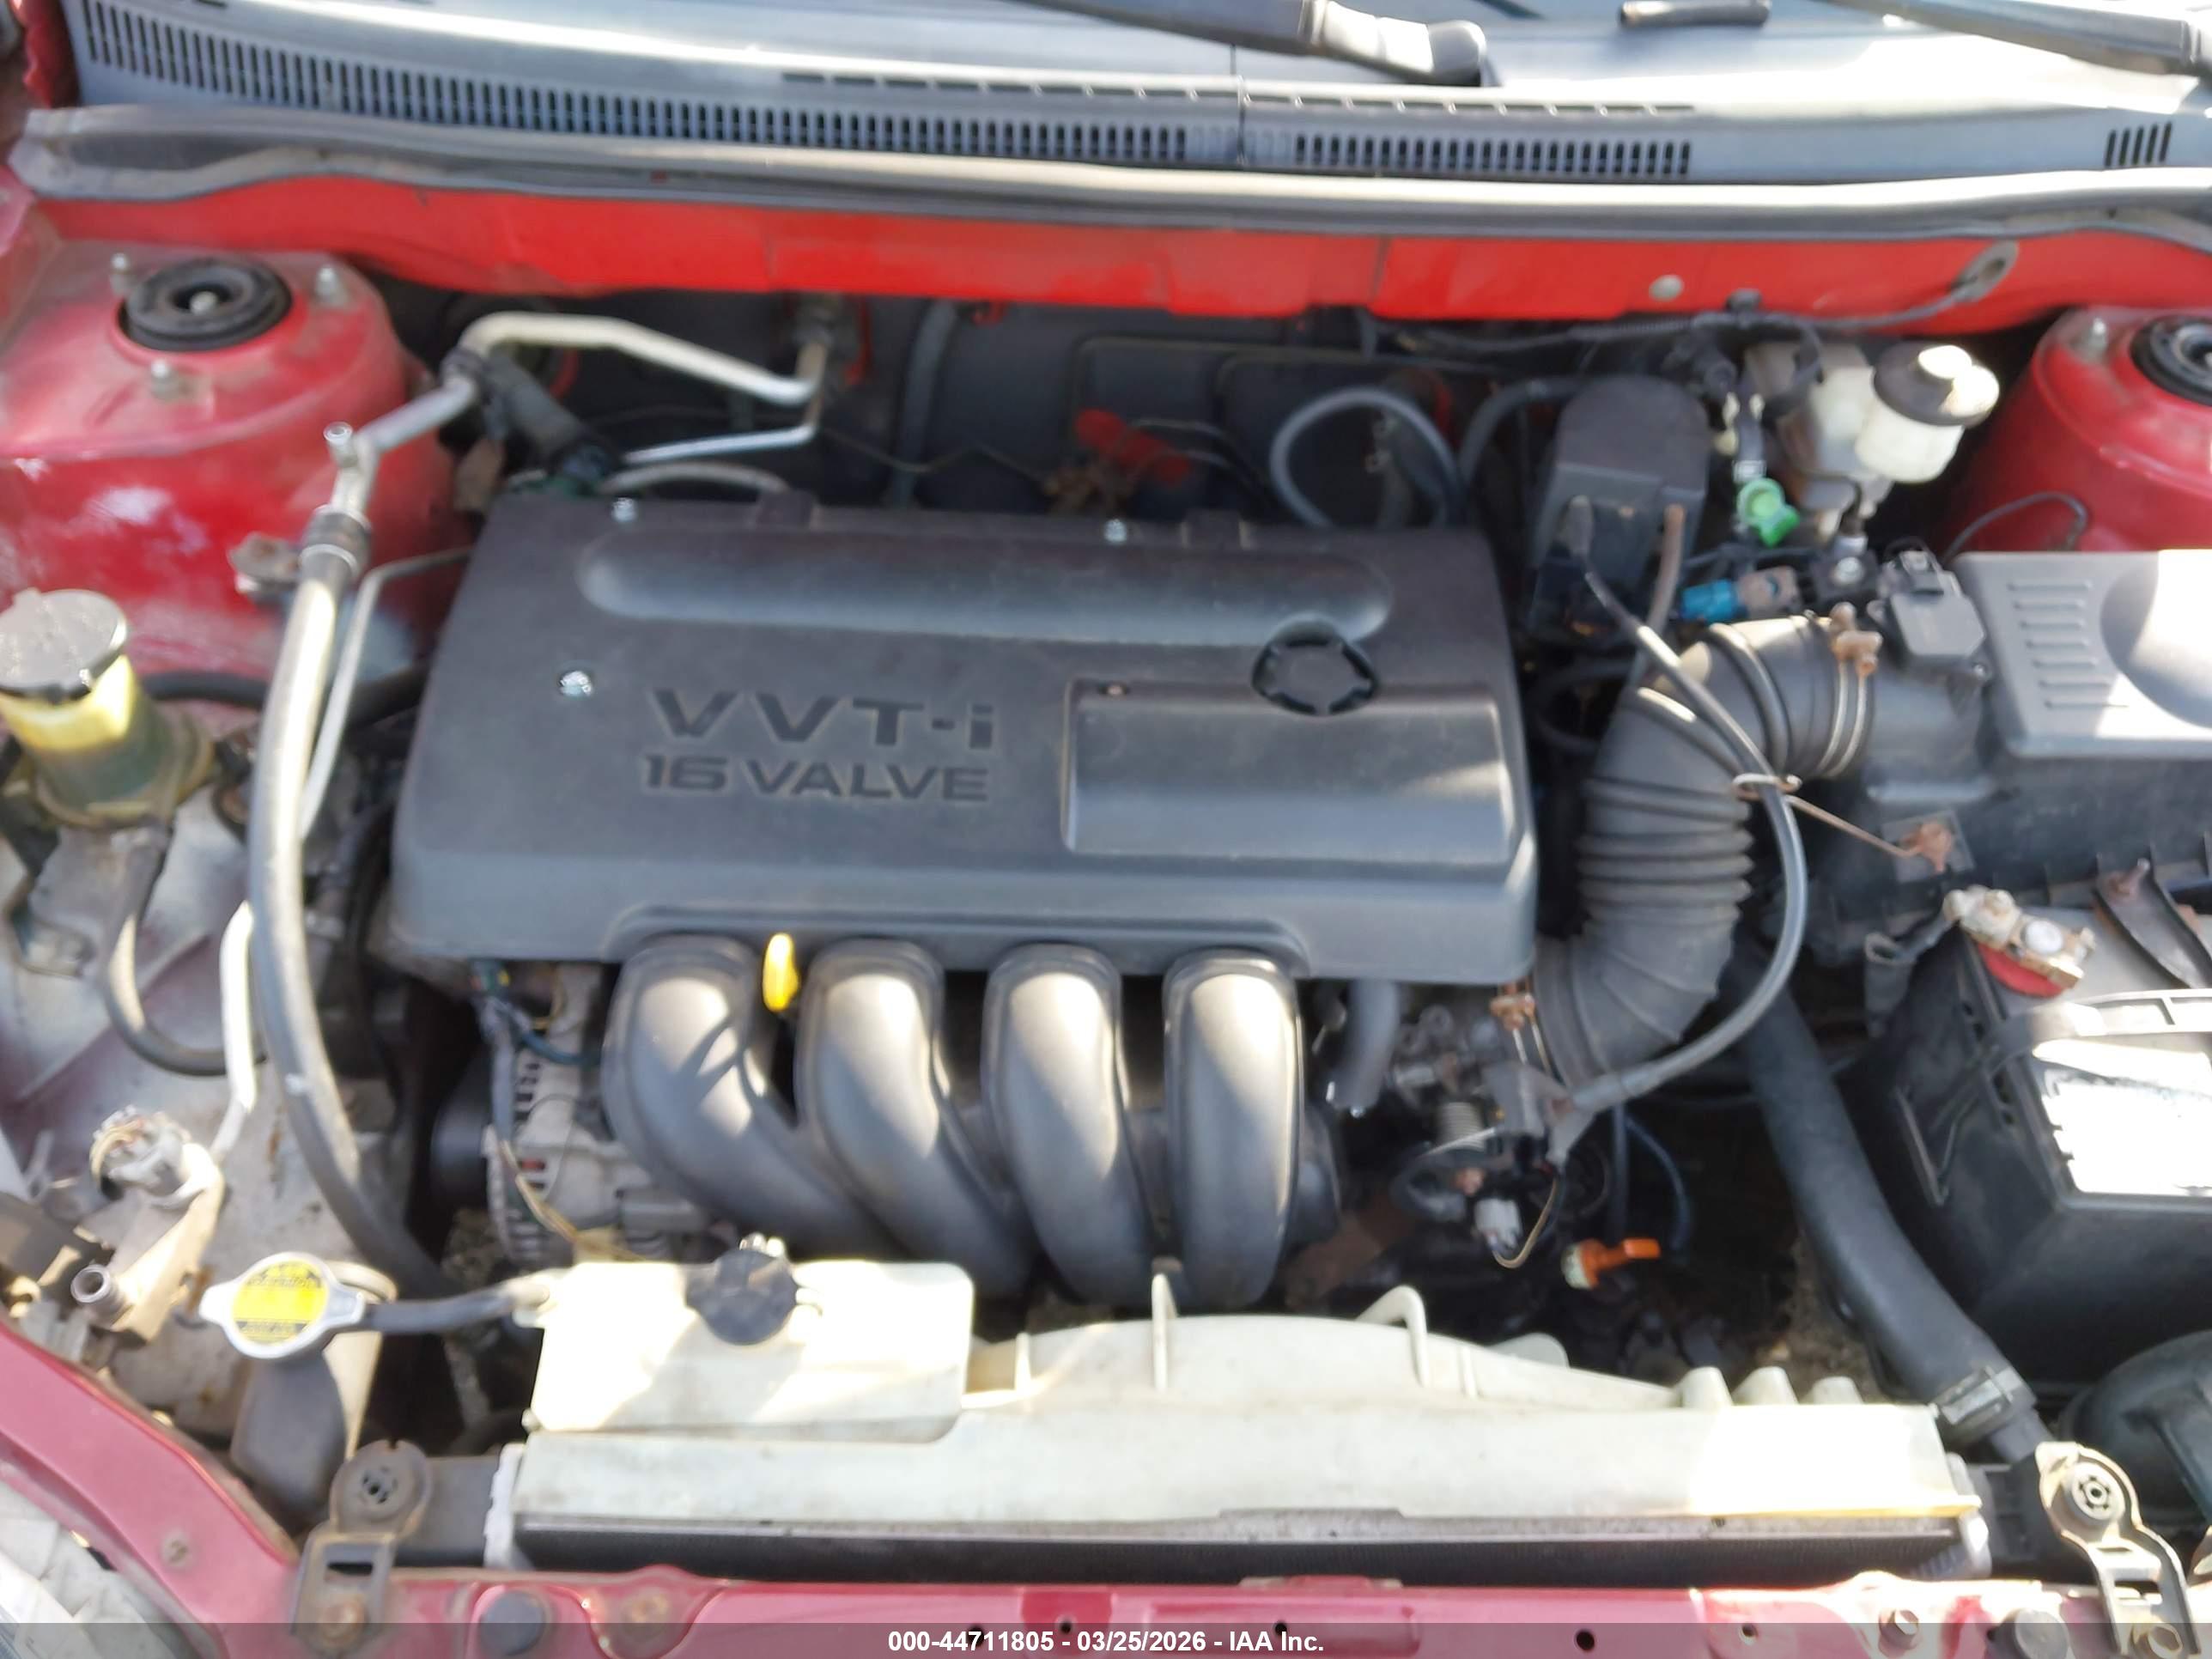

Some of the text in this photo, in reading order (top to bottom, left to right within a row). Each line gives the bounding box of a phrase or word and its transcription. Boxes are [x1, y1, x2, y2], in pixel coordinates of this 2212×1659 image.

[652, 687, 994, 750] VVT-i
[644, 754, 989, 802] 16 VALVE
